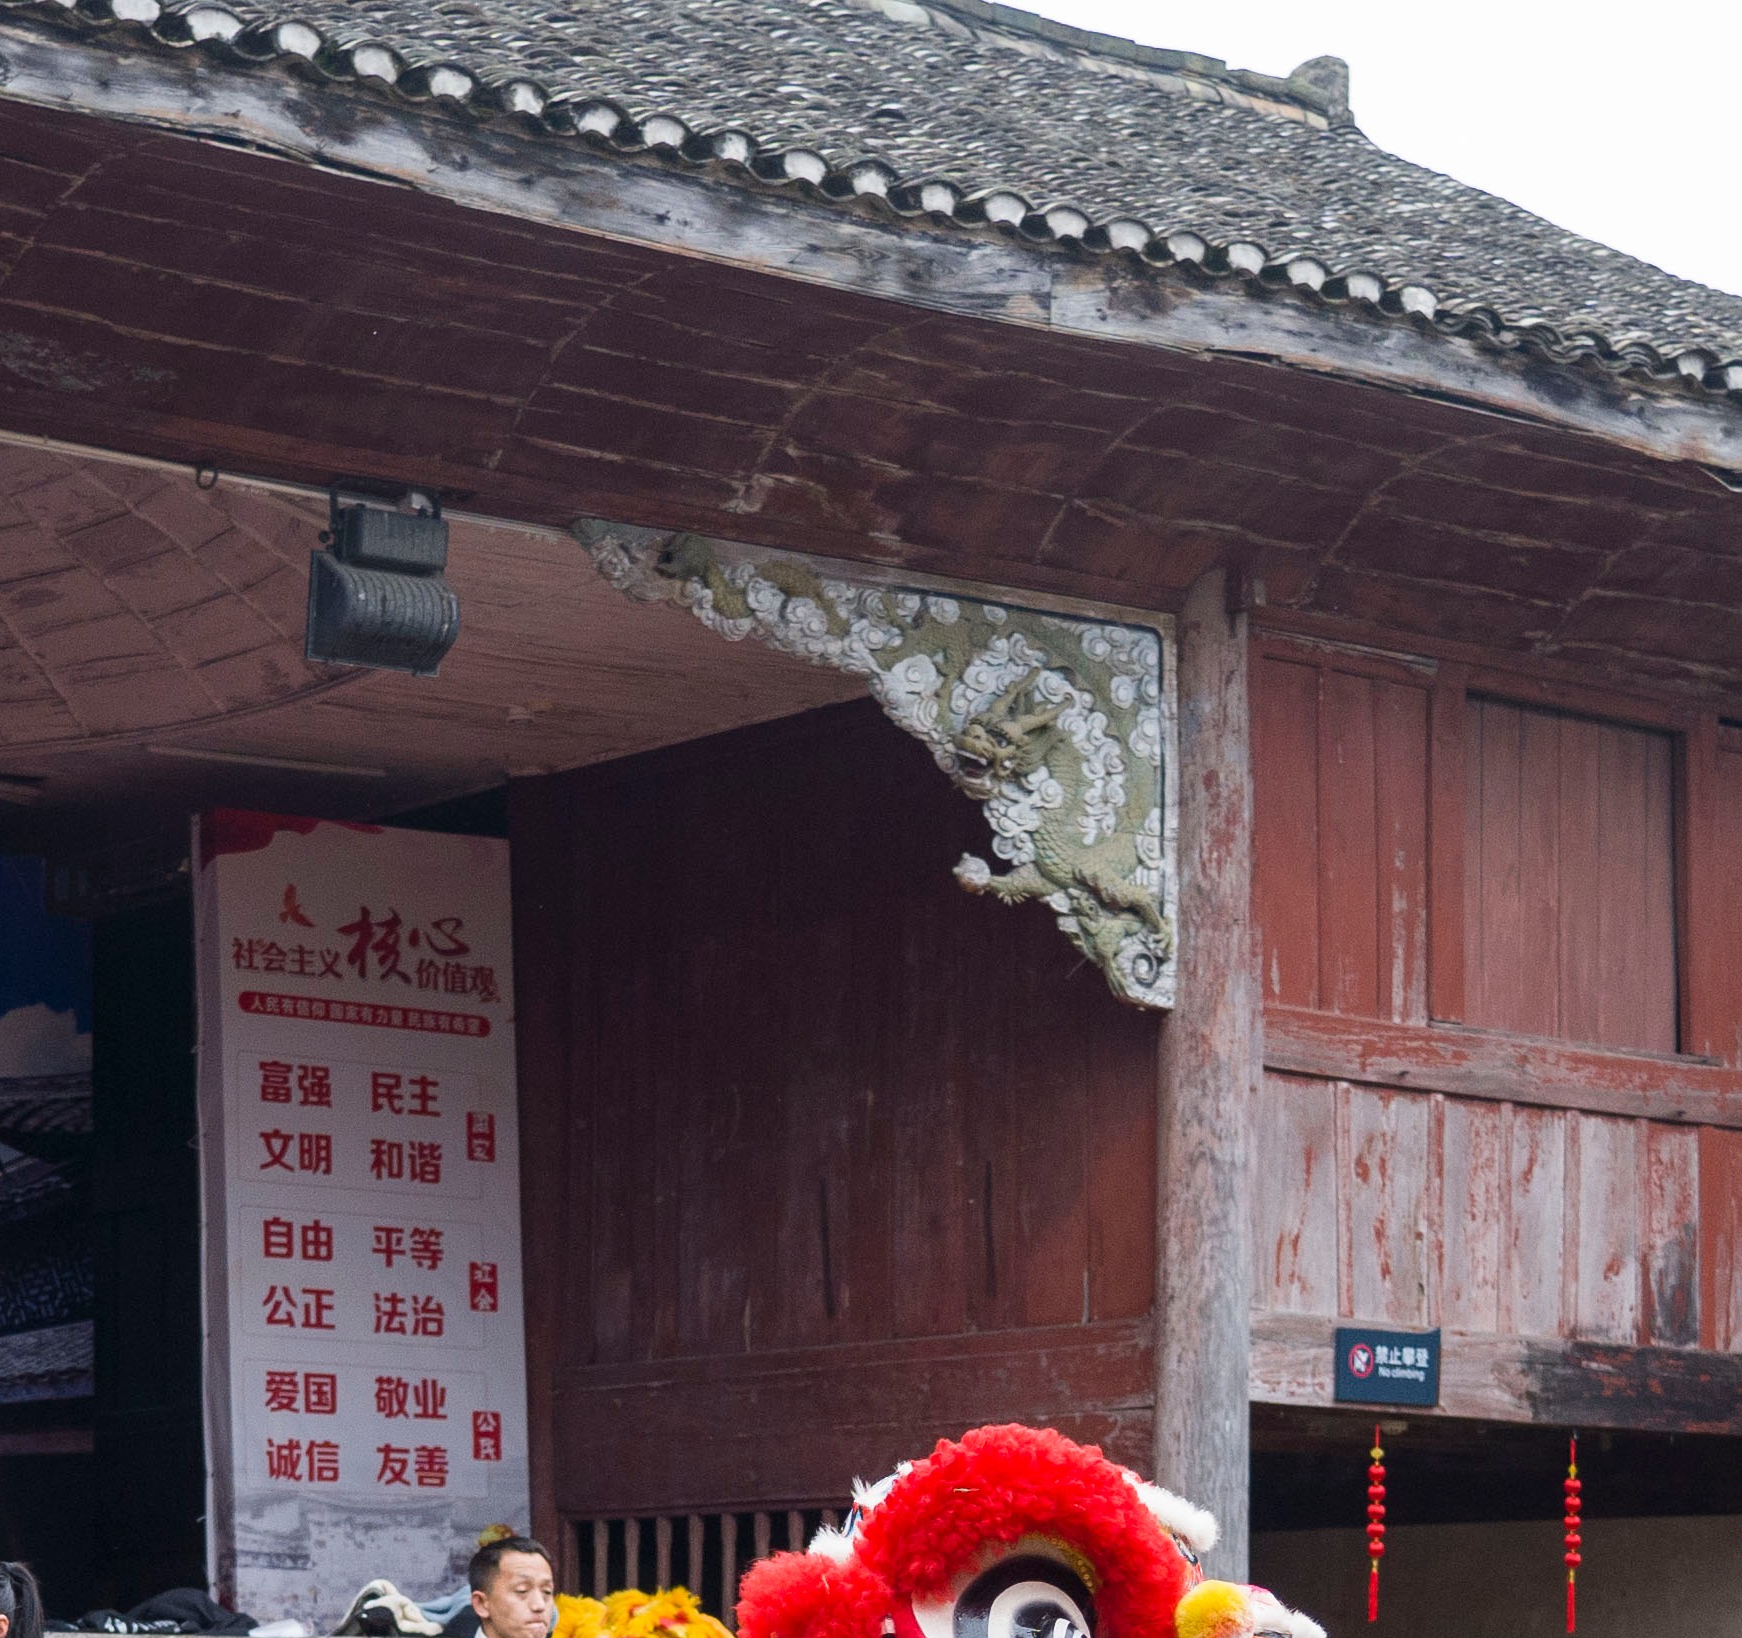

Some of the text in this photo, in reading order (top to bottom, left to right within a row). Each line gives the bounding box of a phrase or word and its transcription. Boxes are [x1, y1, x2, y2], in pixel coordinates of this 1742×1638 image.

[232, 905, 498, 998] 社会主义 核心 价值观
[259, 1061, 442, 1118] 富强 民主
[259, 1128, 443, 1184] 文明 和谐
[263, 1216, 445, 1271] 自由 平等
[262, 1285, 445, 1337] 公正 法治
[472, 1262, 494, 1311] 社会
[1374, 1344, 1430, 1368] 禁止攀登
[1378, 1367, 1390, 1378] No
[265, 1370, 447, 1421] 爱国 敬业
[476, 1411, 498, 1459] 公民
[266, 1437, 449, 1487] 诚信 友善
